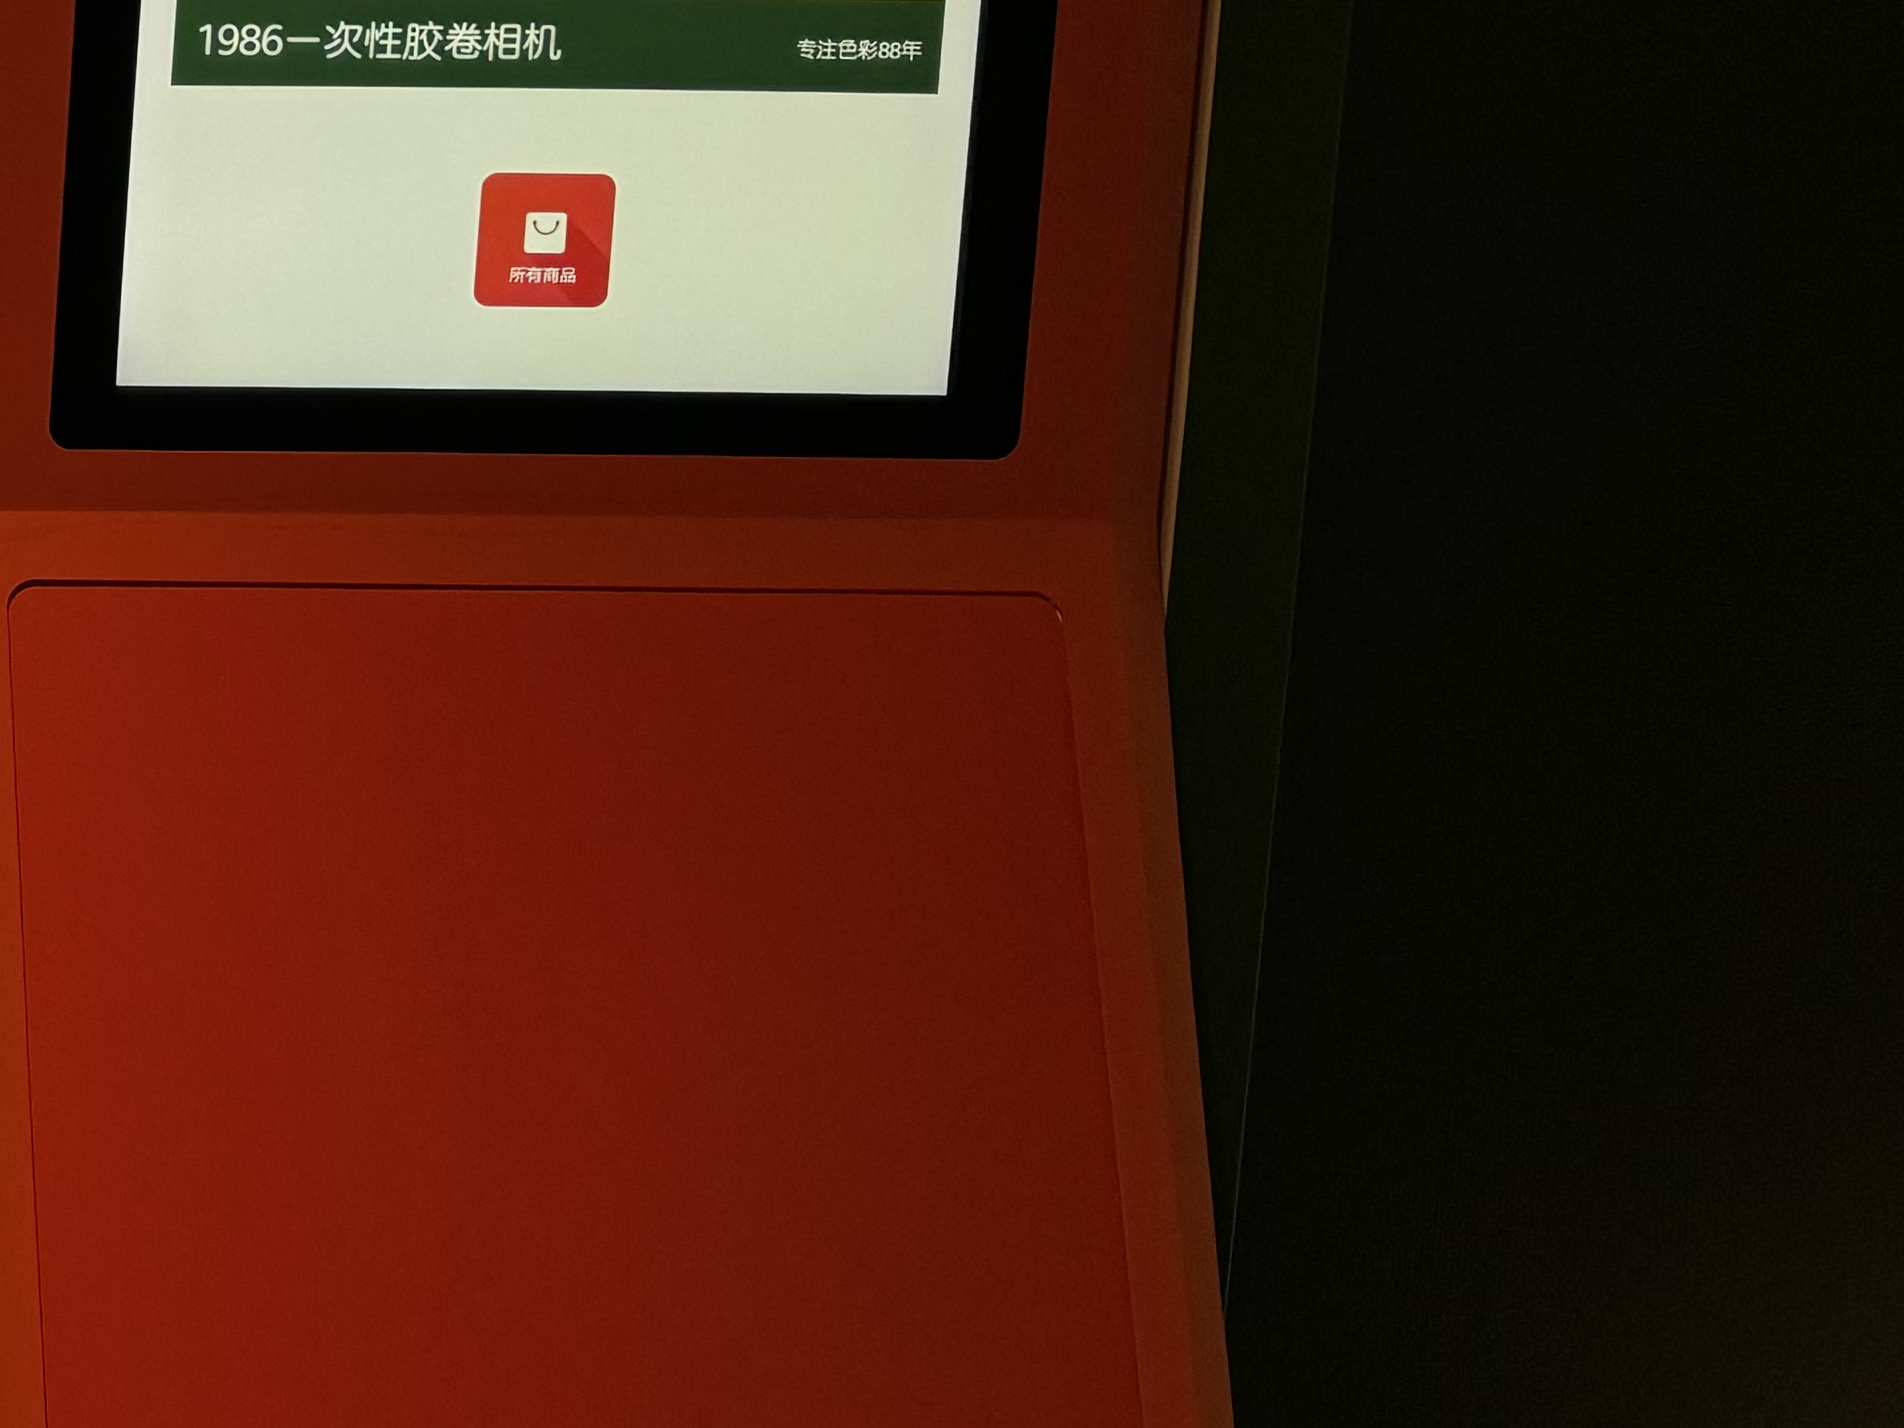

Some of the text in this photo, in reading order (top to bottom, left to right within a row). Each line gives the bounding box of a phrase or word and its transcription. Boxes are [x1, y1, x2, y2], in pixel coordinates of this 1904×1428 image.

[198, 20, 923, 62] 1986一次性胶卷相机 专注色彩88年
[509, 266, 577, 284] 所有商品
